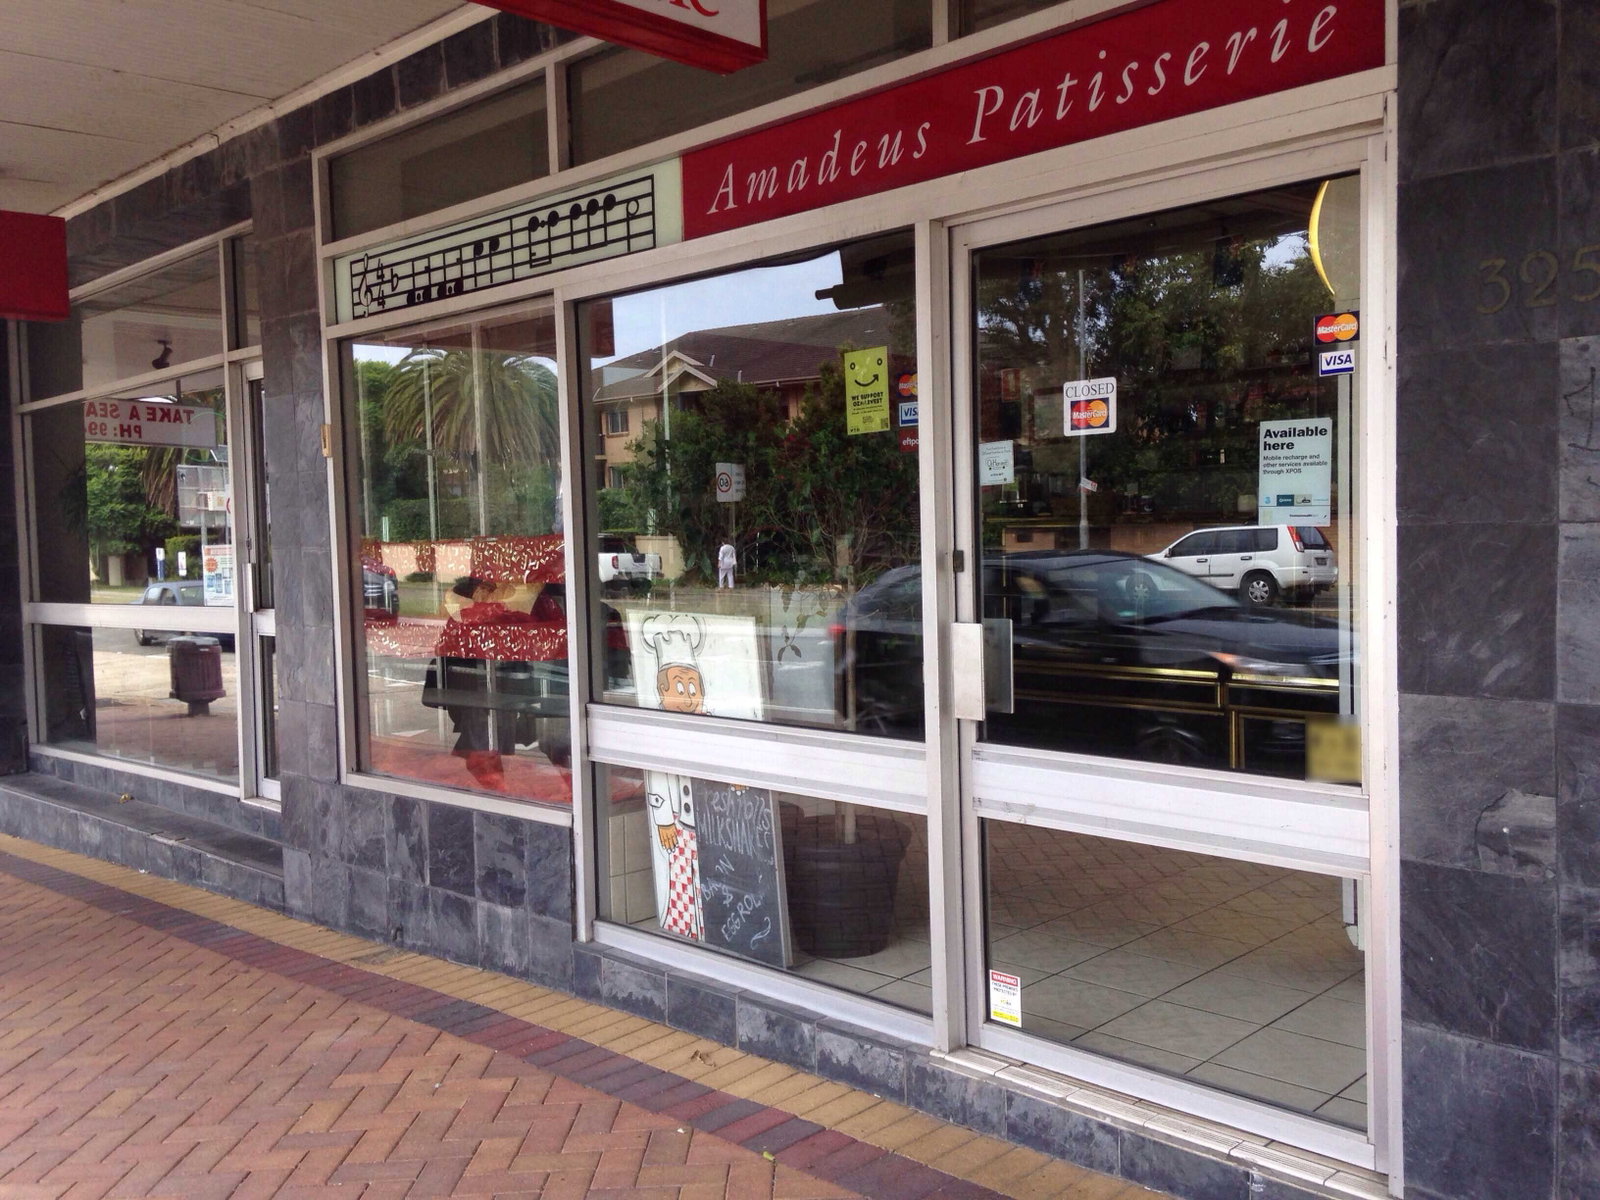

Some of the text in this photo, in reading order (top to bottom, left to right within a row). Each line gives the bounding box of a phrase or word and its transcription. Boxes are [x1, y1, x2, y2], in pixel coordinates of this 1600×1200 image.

[707, 0, 1338, 215] Amadeus Patisserie
[1477, 243, 1600, 315] 325
[1325, 354, 1353, 366] VISA
[1065, 382, 1115, 398] CLOSED
[904, 407, 918, 417] VIS
[1263, 426, 1328, 439] Available
[1263, 441, 1295, 451] here
